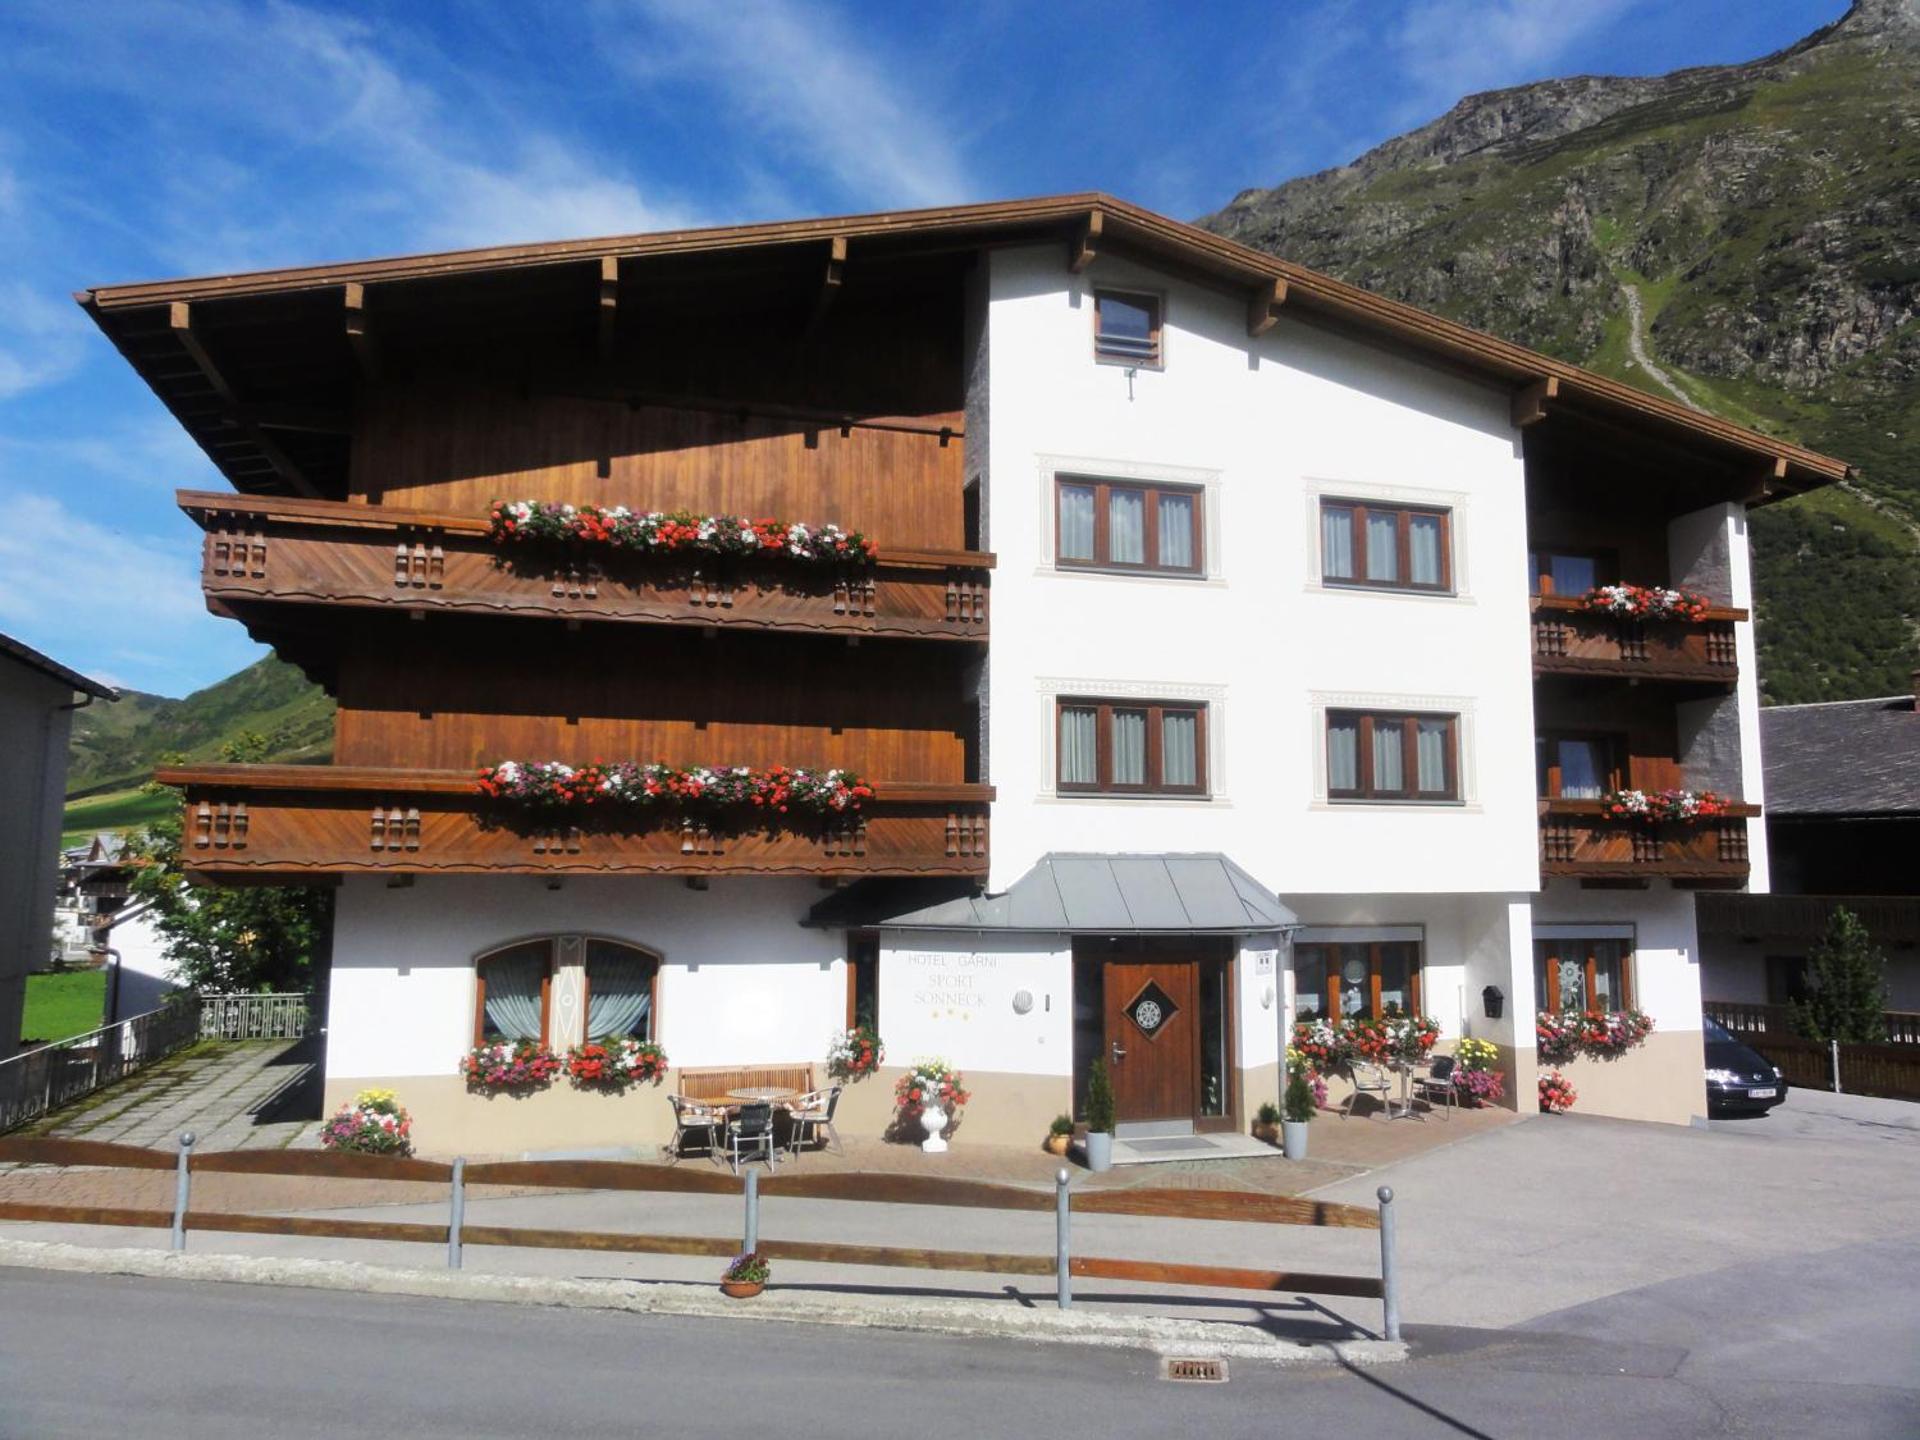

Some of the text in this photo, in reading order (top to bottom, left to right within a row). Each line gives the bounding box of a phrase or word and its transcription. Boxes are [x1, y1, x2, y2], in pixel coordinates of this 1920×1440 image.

[908, 954, 997, 969] HOTEL GARNI
[928, 973, 974, 989] SPORT
[914, 991, 986, 1007] SONNECK
